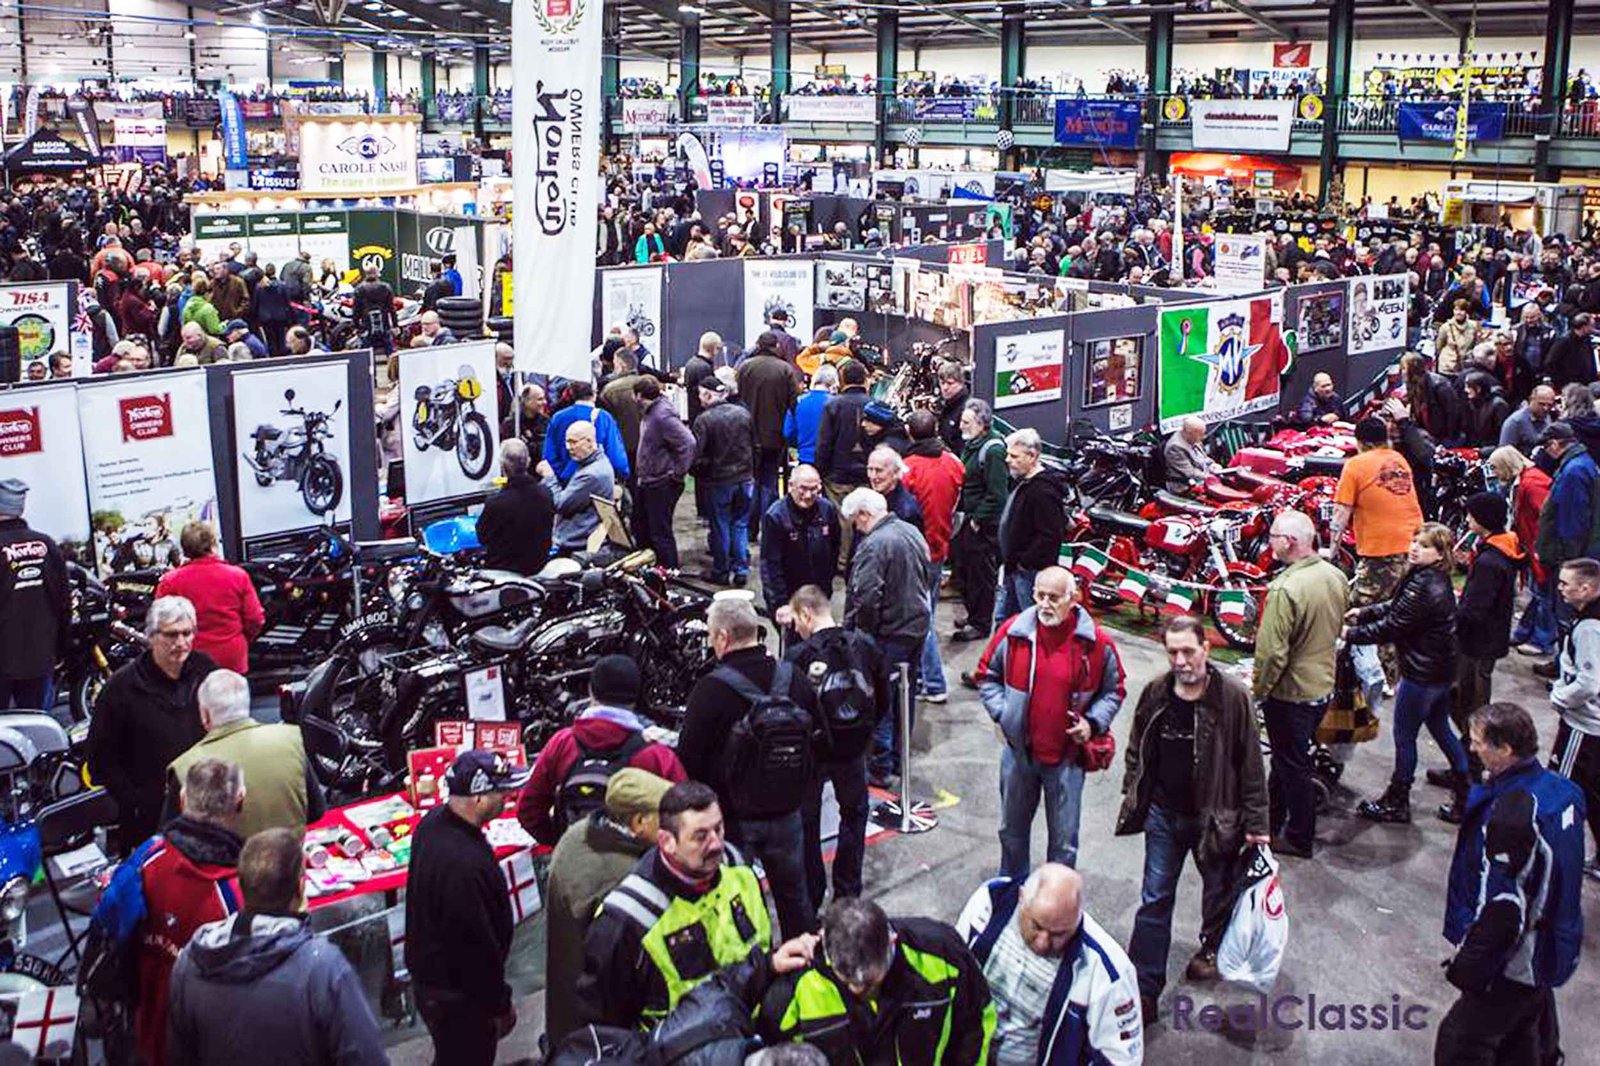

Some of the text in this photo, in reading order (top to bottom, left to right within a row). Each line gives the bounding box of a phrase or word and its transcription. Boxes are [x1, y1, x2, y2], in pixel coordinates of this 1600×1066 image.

[319, 161, 408, 174] CAROLE NASH
[252, 176, 296, 188] 12 ISSUES
[951, 249, 984, 264] ARIEL
[8, 291, 49, 305] BSA
[467, 380, 475, 397] 1
[126, 405, 164, 423] Norton
[130, 419, 163, 430] OWNERS
[136, 427, 158, 436] CLUB
[2, 443, 26, 452] CLUB
[2, 541, 48, 562] Norton
[366, 611, 388, 625] 800
